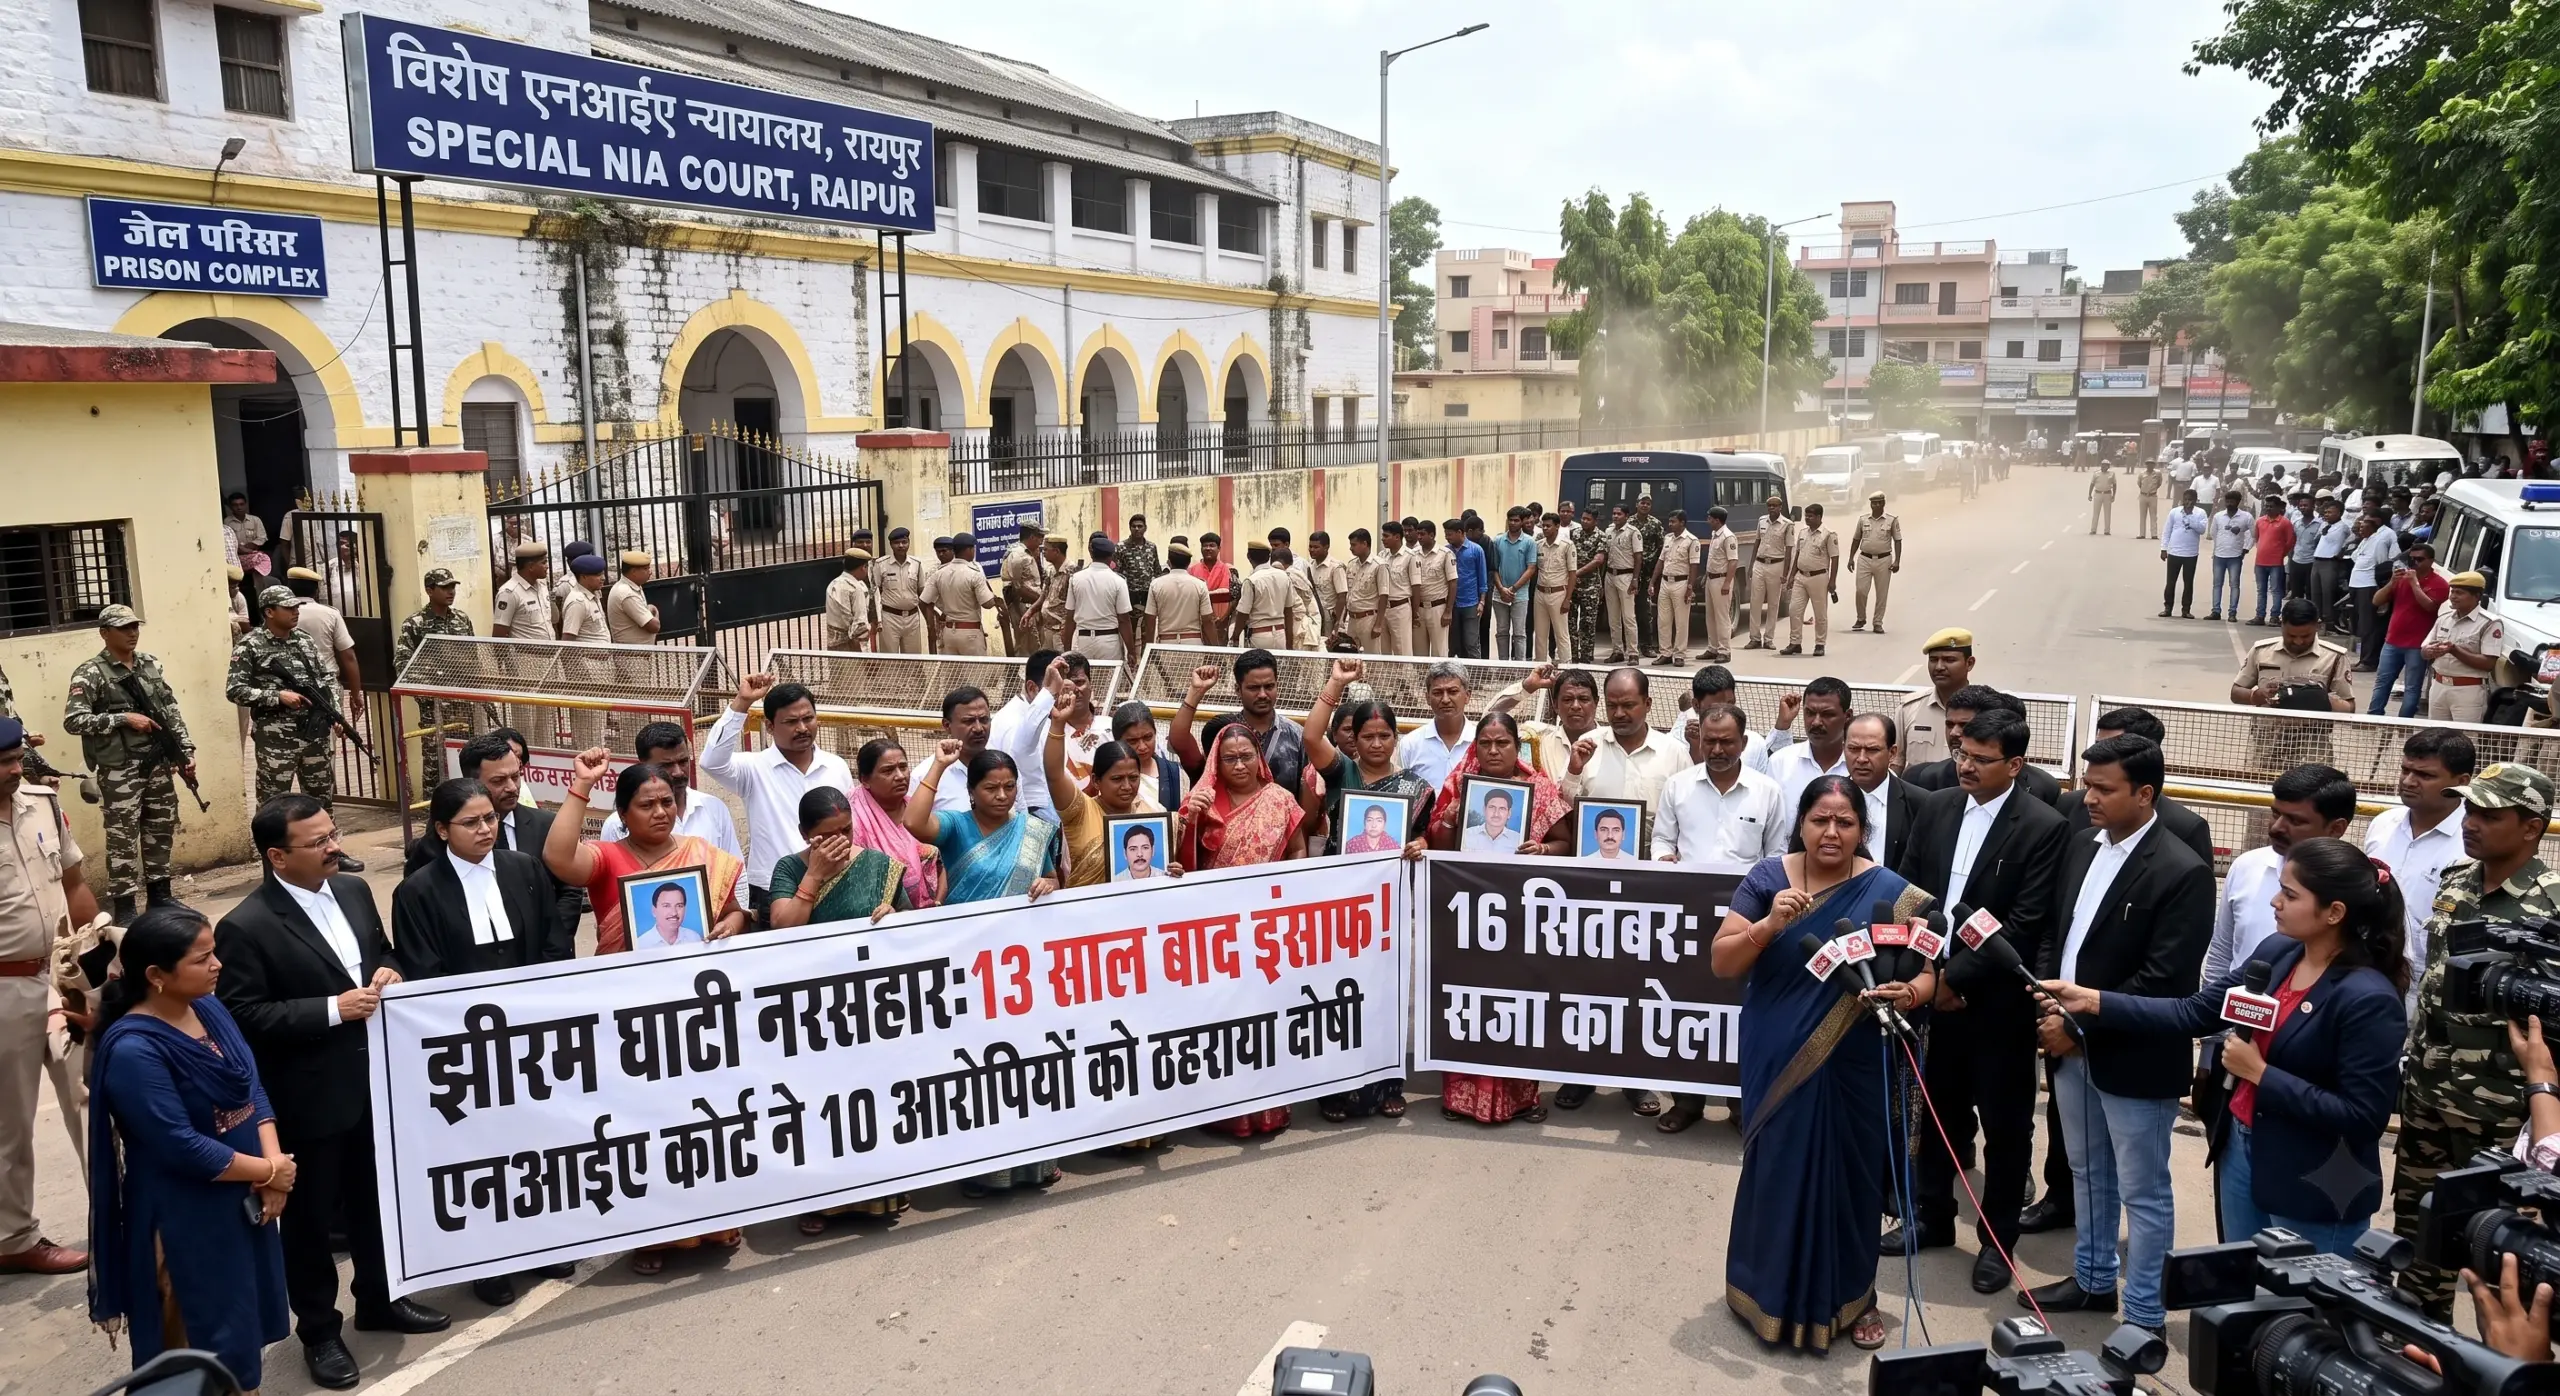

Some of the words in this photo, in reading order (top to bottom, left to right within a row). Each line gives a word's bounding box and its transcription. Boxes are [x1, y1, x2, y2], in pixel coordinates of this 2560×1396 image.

[386, 32, 509, 105] विशेष
[522, 71, 676, 138] एनआईए
[686, 99, 832, 162] न्यायालय,
[843, 127, 922, 179] रायपुर
[408, 117, 590, 177] SPECIAL
[603, 144, 669, 187] NIA
[680, 156, 799, 210] COURT,
[811, 174, 916, 217] RAIPUR
[104, 256, 200, 281] PRISON
[209, 262, 320, 288] COMPLEX
[120, 211, 190, 249] जेल
[198, 219, 298, 257] परिसर
[1448, 892, 1506, 951] 16
[1521, 878, 1697, 963] सितंबर:
[421, 1004, 599, 1125] झीरम
[614, 970, 741, 1081] घाटी
[754, 946, 967, 1057] नरसंहार:
[972, 945, 1032, 1019] 13
[1044, 928, 1146, 1007] साल
[1158, 914, 1240, 986] बाद
[1251, 884, 1390, 983] इंसाफ!
[1442, 984, 1549, 1048] सजा
[1560, 994, 1628, 1054] का
[1639, 978, 1742, 1063] ऐला
[427, 1114, 650, 1231] एनआईए
[660, 1088, 758, 1189] कोर्ट
[768, 1083, 805, 1166] ने
[820, 1089, 877, 1158] 10
[891, 1029, 1075, 1144] आरोपियों
[1085, 1020, 1139, 1101] को
[1148, 1012, 1277, 1090] ठहराया
[1287, 978, 1364, 1059] दोषी
